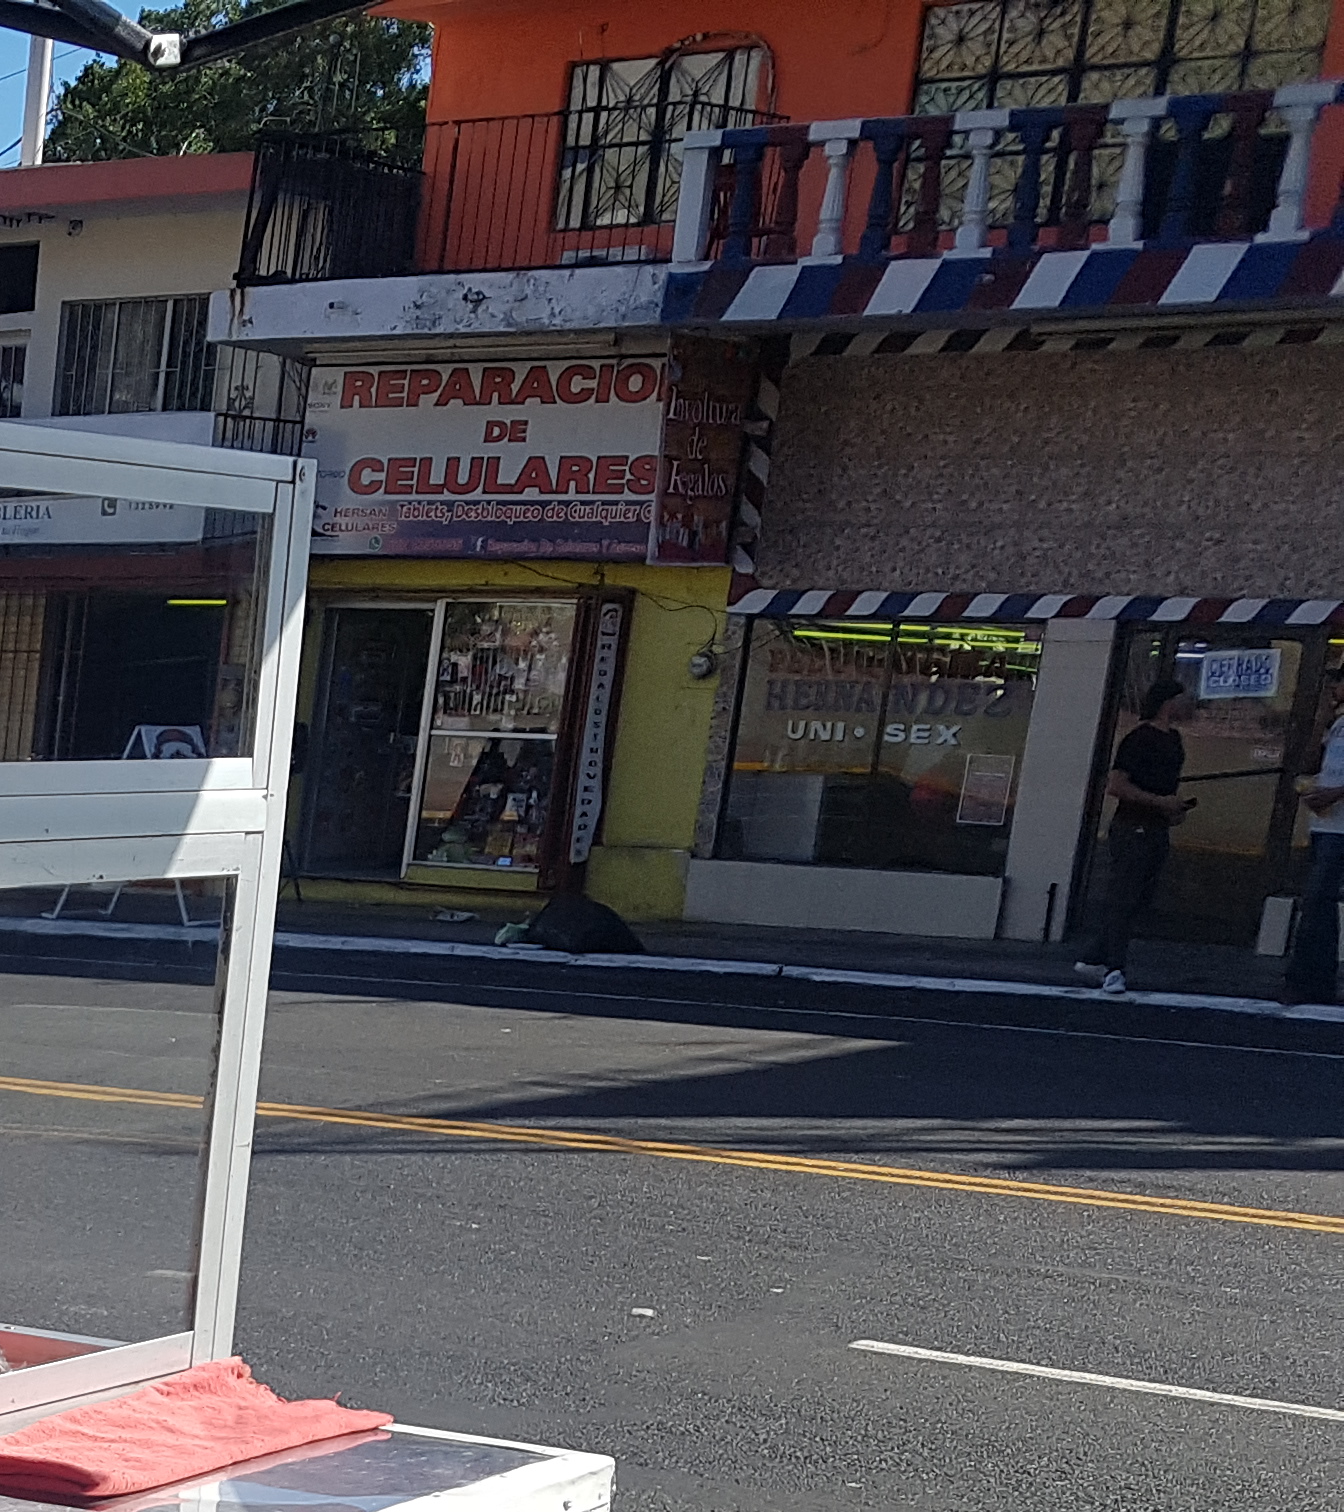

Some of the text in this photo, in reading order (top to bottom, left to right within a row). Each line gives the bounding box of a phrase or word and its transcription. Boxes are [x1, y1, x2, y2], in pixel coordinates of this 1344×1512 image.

[340, 362, 666, 410] REPARACIO
[483, 419, 529, 443] DE
[688, 427, 707, 460] de
[348, 455, 658, 495] CELULARES
[333, 507, 388, 519] HERSAN
[454, 502, 542, 525] Desbloqueo
[544, 502, 565, 521] de
[567, 502, 638, 525] Cualquier
[321, 522, 397, 533] CELULARES
[1208, 675, 1272, 688] CLOSED
[787, 719, 962, 746] UNI SEX
